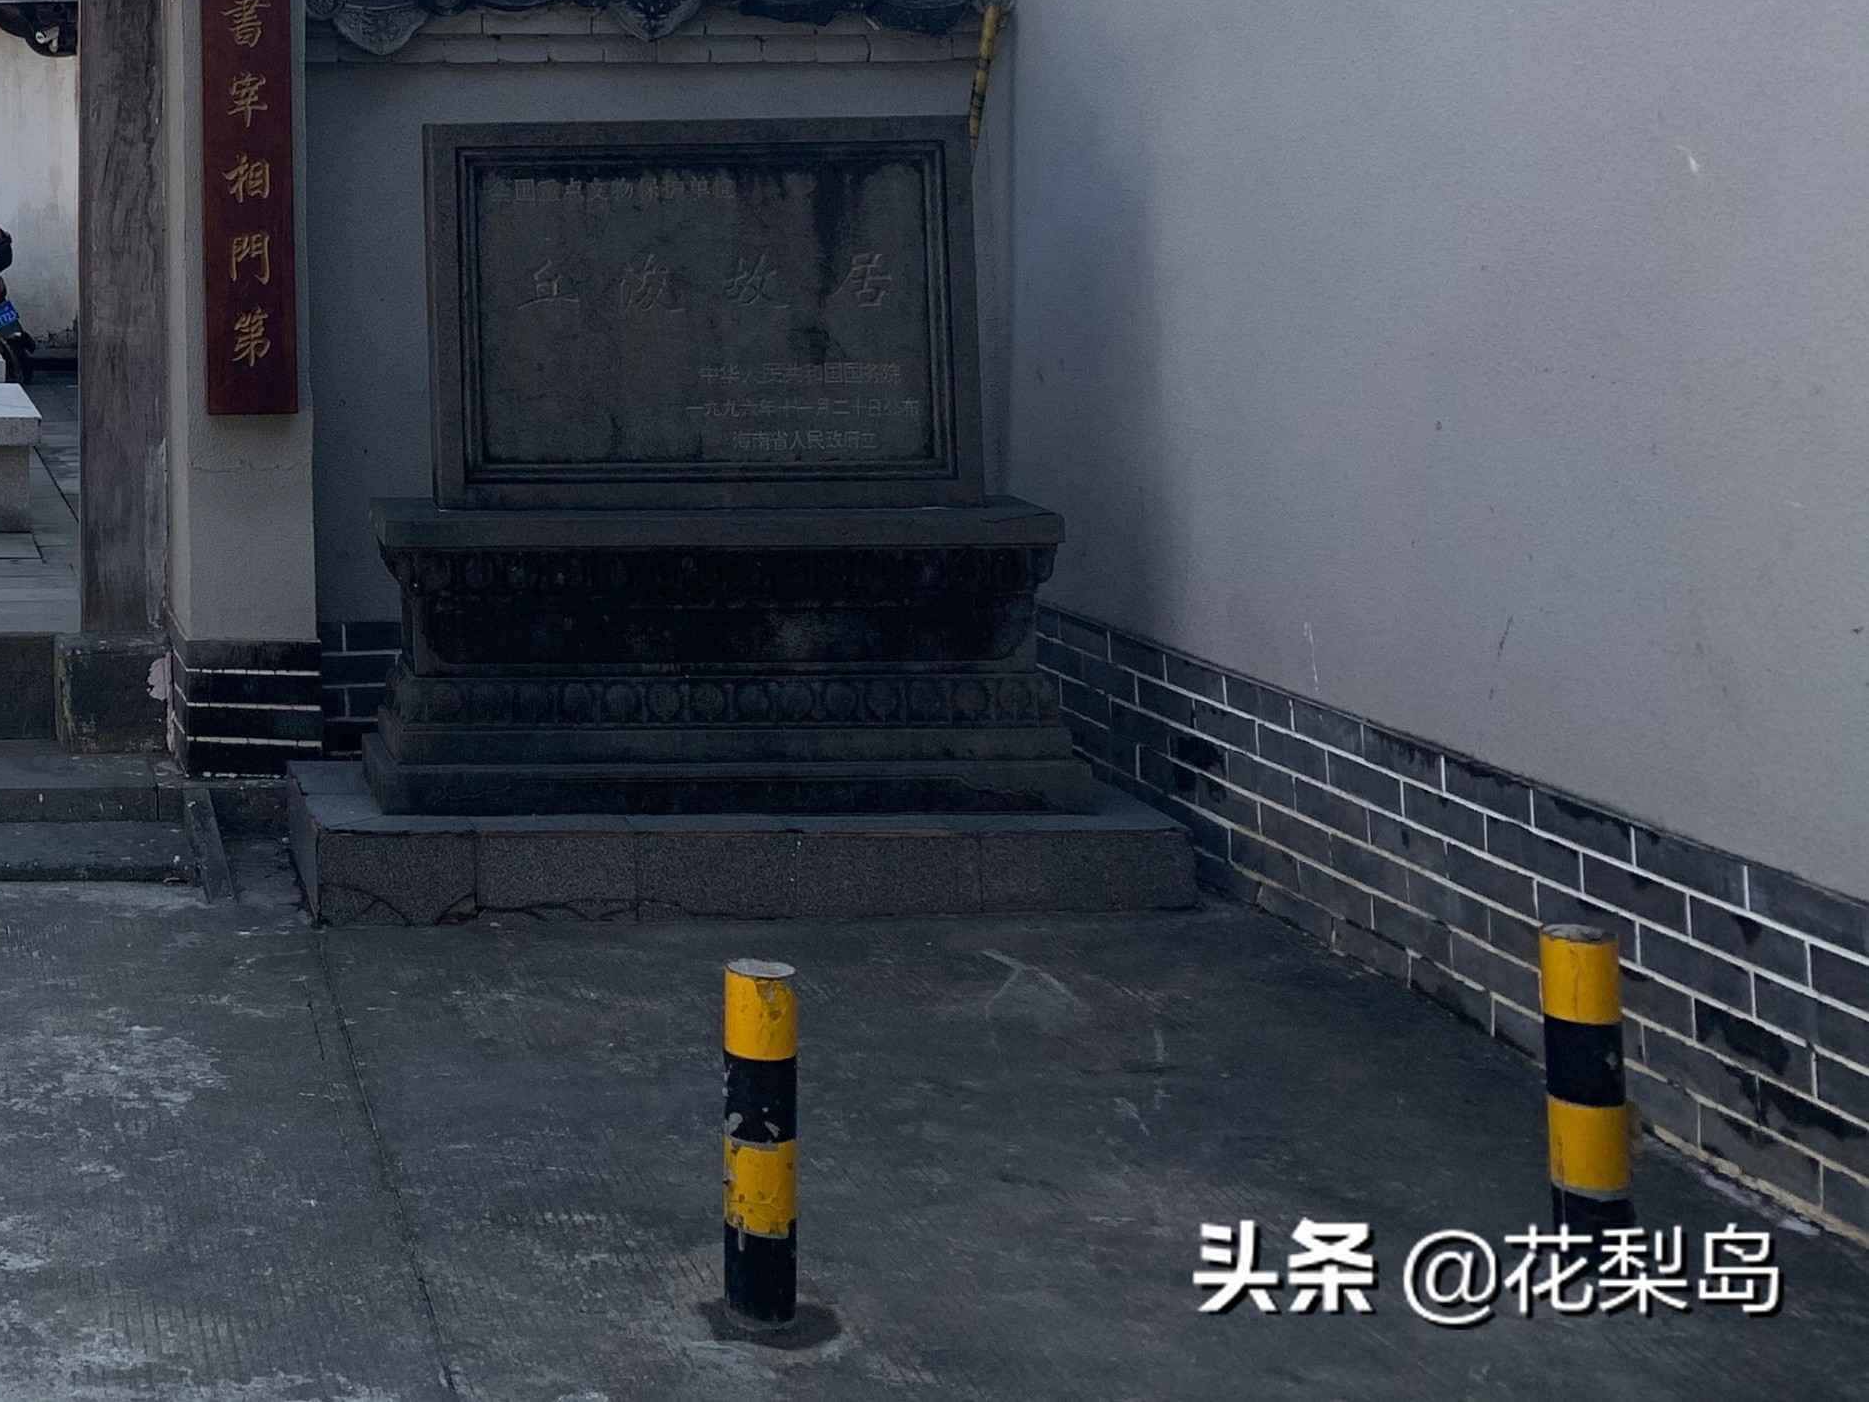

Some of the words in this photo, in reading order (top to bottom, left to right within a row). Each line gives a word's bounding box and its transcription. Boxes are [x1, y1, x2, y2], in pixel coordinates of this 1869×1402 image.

[699, 361, 902, 385] 中华人民共和国国务院
[685, 397, 920, 418] 一九九六年十一月二十日公布
[732, 429, 878, 450] 海南省人民政府立
